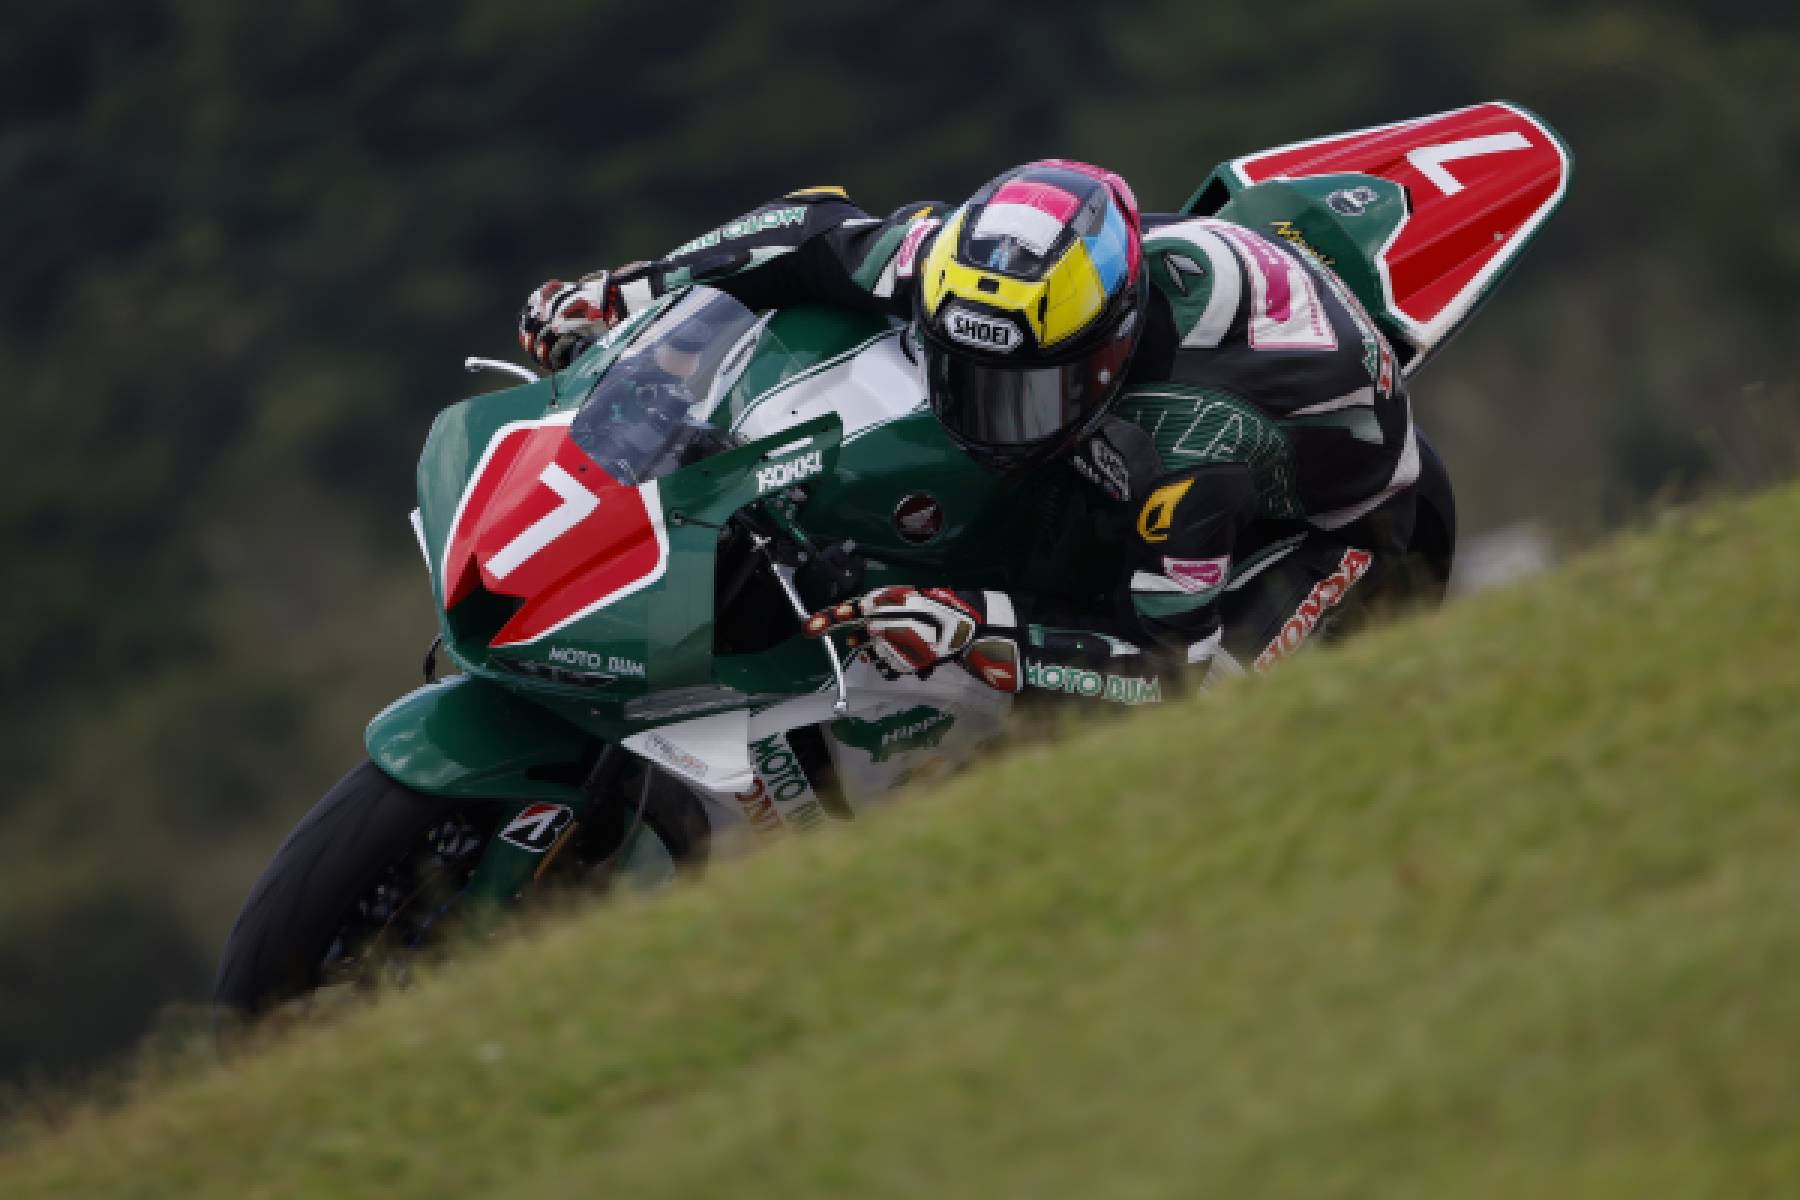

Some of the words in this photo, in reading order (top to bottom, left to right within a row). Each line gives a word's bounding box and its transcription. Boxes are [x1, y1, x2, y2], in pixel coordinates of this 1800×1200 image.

[952, 313, 1012, 347] SHOEI
[483, 461, 601, 581] 7
[550, 648, 601, 670] MOTO
[1026, 656, 1101, 696] MOTO
[749, 731, 808, 802] MOTO
